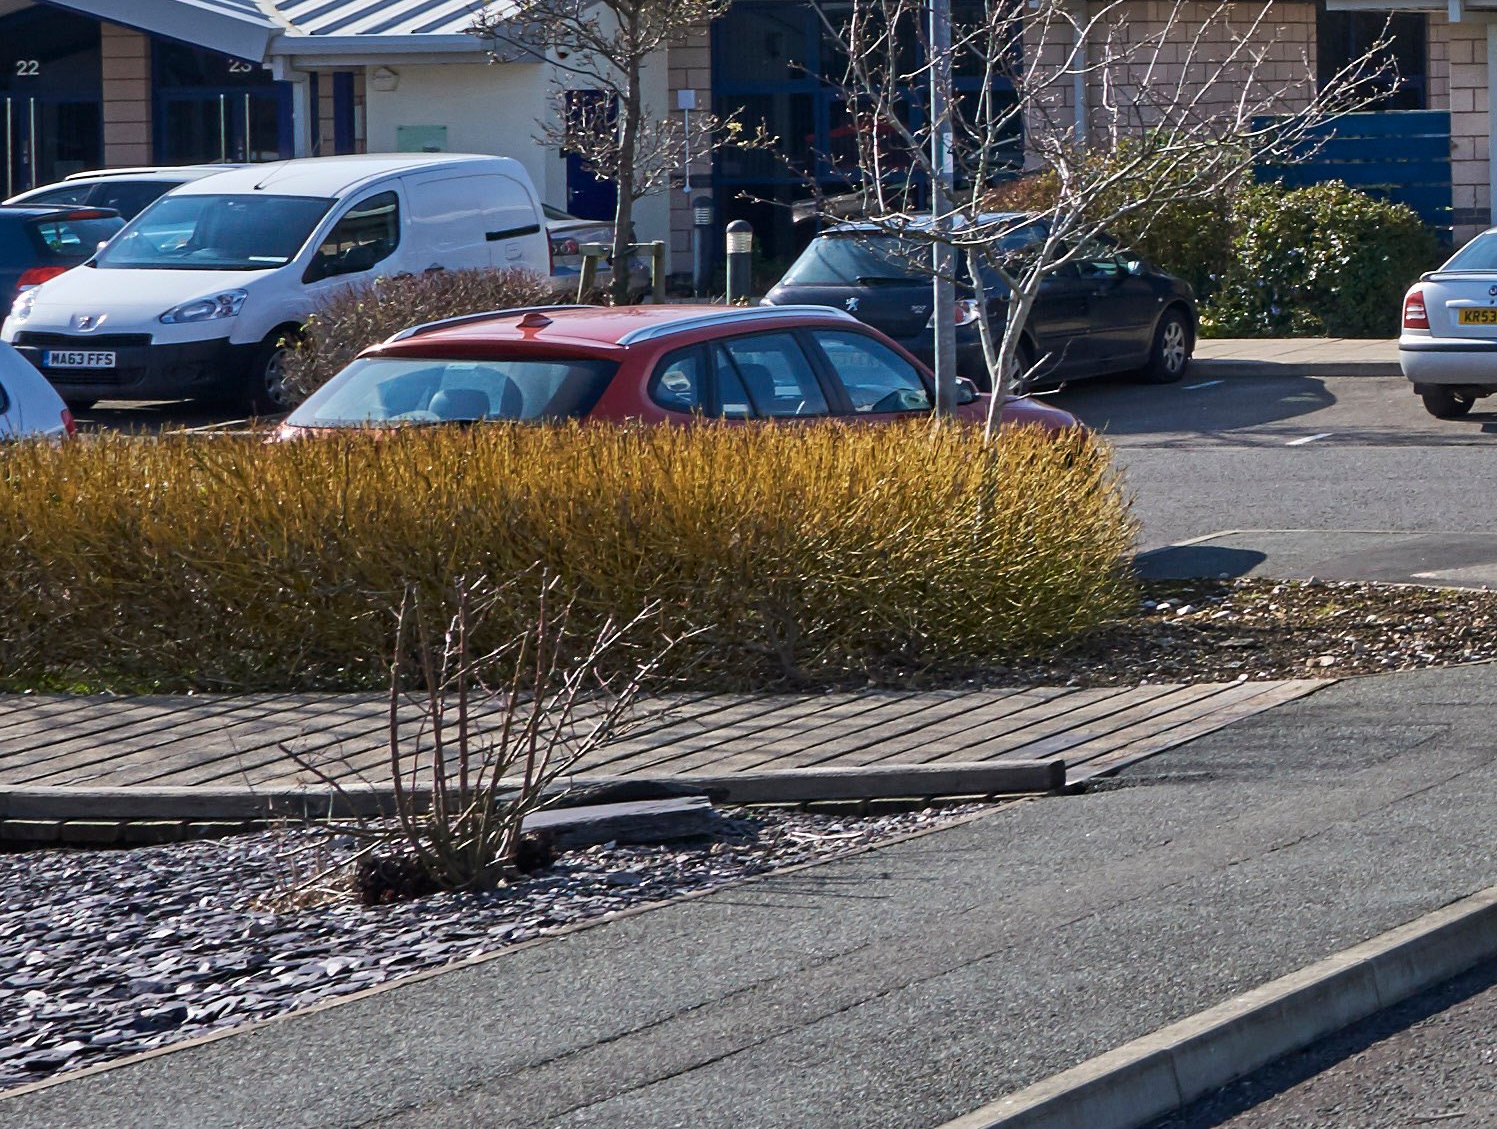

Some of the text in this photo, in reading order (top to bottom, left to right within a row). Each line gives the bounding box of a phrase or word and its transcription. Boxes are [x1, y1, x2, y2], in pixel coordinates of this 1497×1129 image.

[16, 60, 40, 76] 22
[1464, 311, 1497, 323] KR53
[51, 353, 113, 365] MA63 FFS
